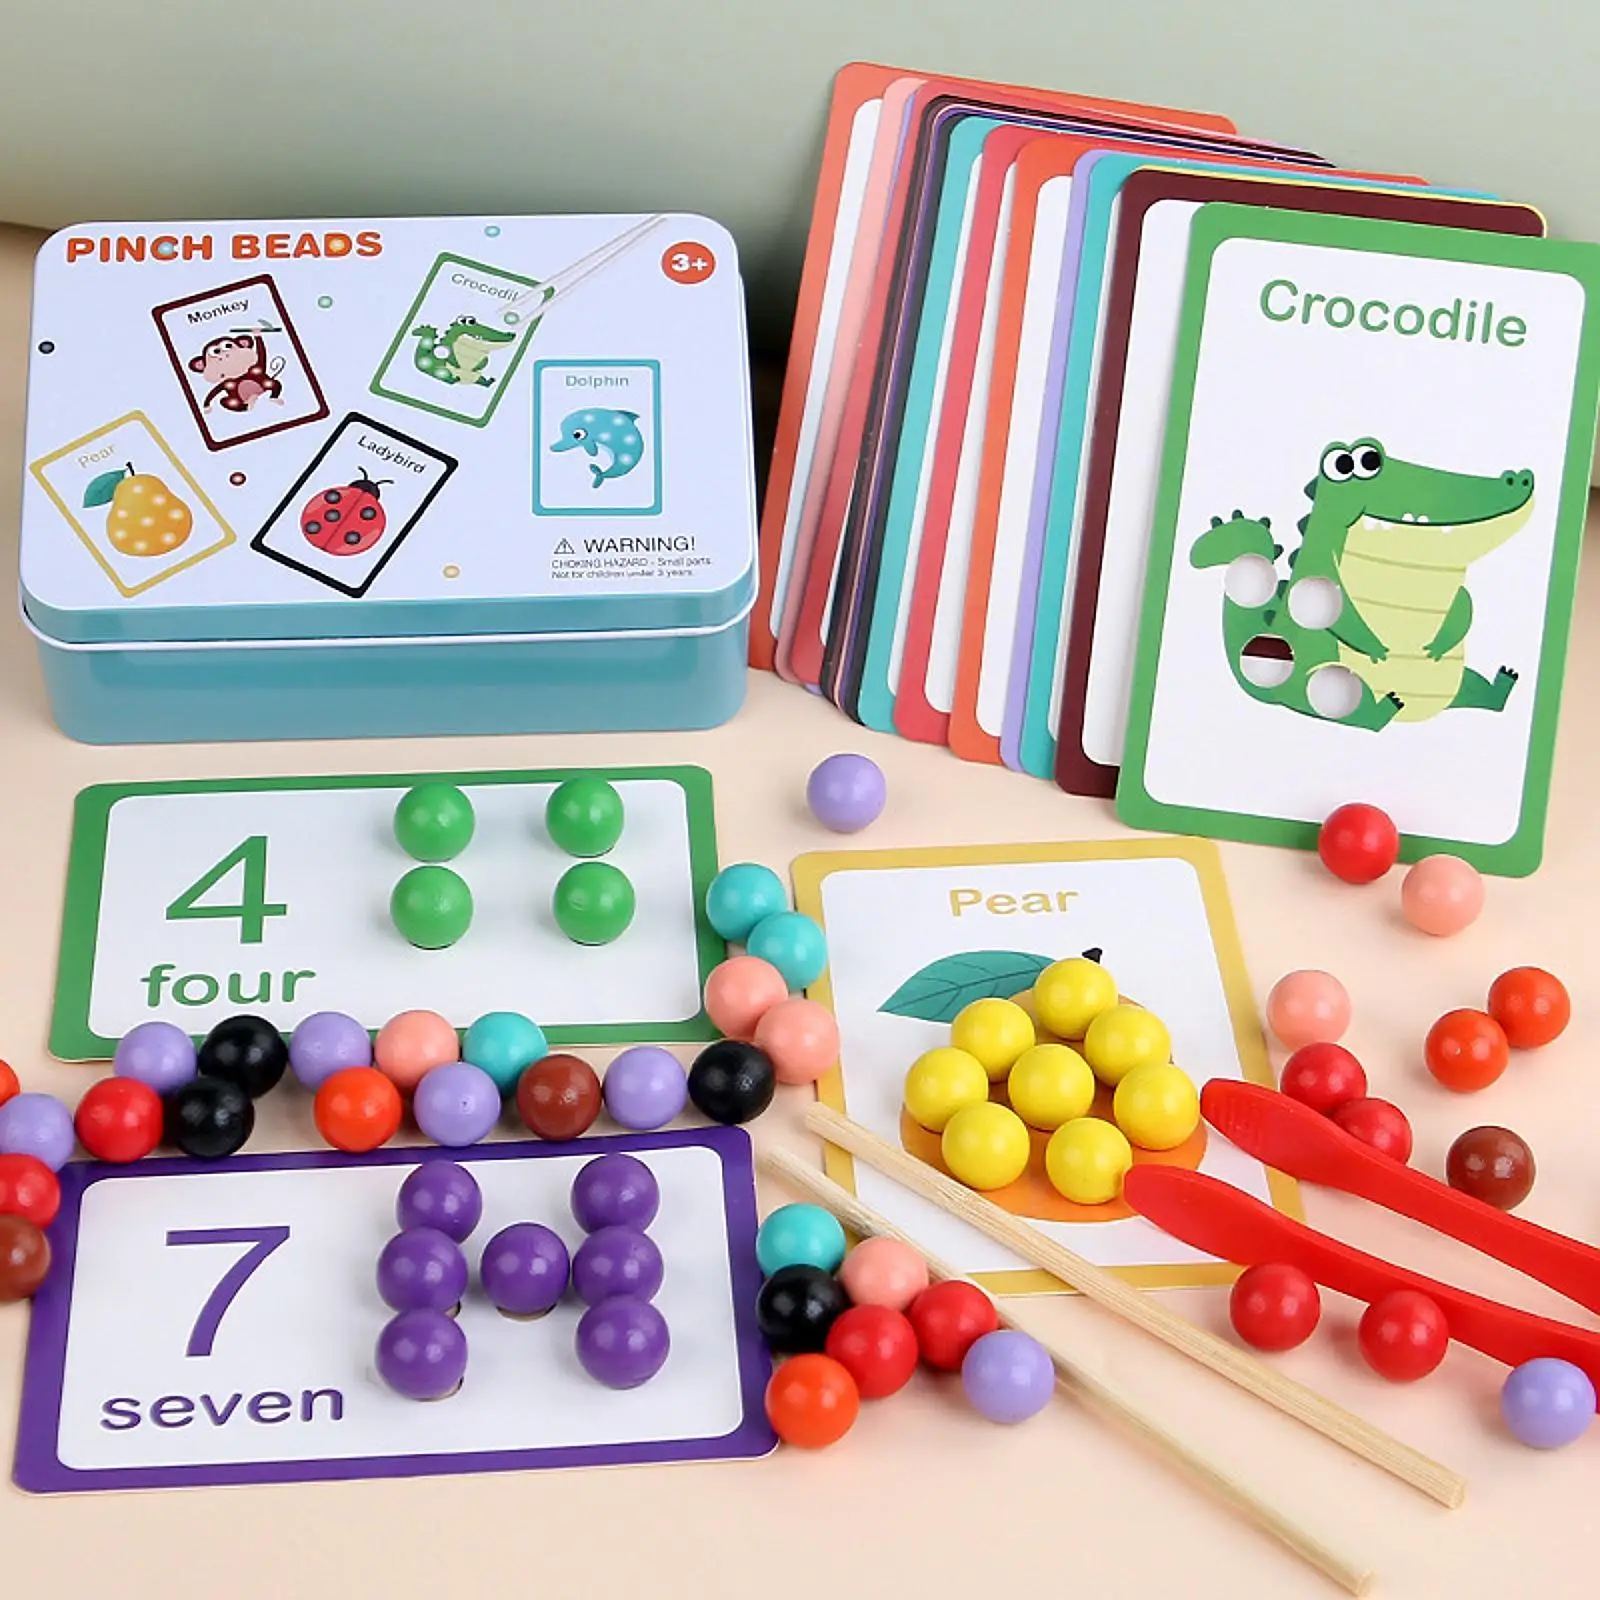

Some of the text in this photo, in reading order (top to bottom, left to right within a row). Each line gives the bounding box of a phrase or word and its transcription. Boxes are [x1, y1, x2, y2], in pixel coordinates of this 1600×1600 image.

[66, 232, 383, 262] PINCH BEADS
[671, 253, 707, 272] 3+
[452, 274, 519, 301] Crocodil
[187, 300, 249, 324] Monkey
[1259, 278, 1529, 348] Crocodile
[565, 375, 629, 388] Dolphin
[78, 444, 116, 469] Pear
[358, 435, 427, 474] Ladybird
[584, 536, 695, 553] WARNING!
[552, 558, 602, 569] CHOKING
[604, 558, 648, 567] HAZARD
[658, 557, 685, 567] Small
[552, 570, 570, 579] Not
[572, 570, 584, 579] for
[586, 569, 625, 579] children
[628, 569, 654, 578] under
[165, 835, 287, 944] 4
[948, 887, 1079, 918] Pear
[140, 963, 316, 1007] four
[165, 1226, 291, 1358] 7
[100, 1385, 345, 1430] seven
